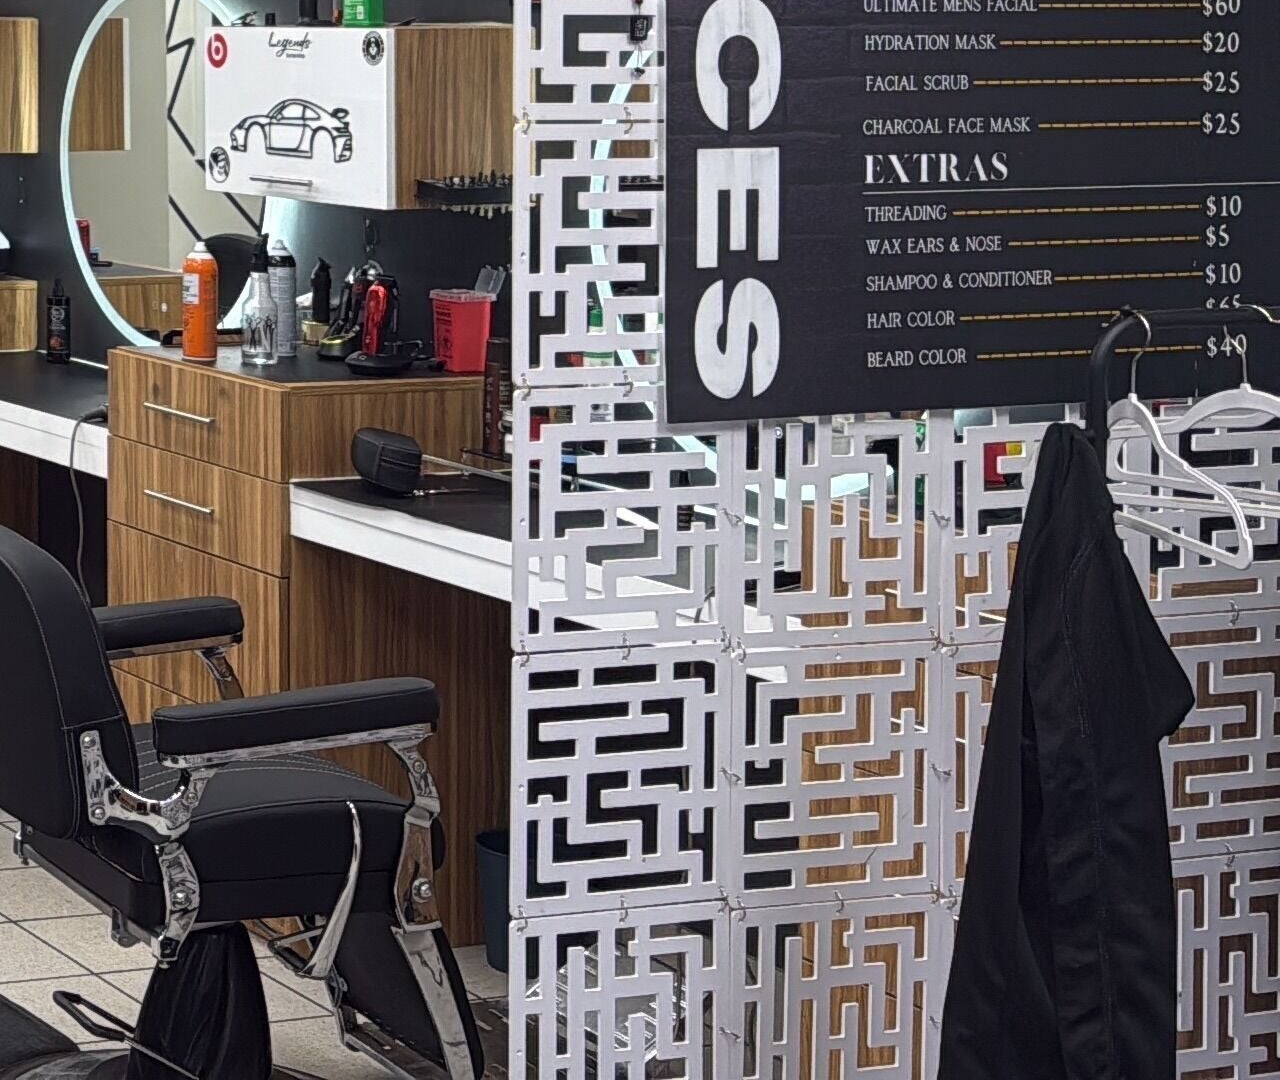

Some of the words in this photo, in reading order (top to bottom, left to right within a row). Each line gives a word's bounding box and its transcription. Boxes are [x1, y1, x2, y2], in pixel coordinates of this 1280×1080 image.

[268, 21, 312, 57] Legends
[864, 34, 950, 51] HYDRATION
[954, 33, 997, 50] MASK
[1202, 31, 1240, 53] $20
[865, 74, 918, 92] FACIAL
[923, 74, 969, 91] SCRUB
[1203, 70, 1240, 94] $25
[862, 117, 943, 136] CHARCOAL
[948, 117, 985, 134] FACE
[989, 116, 1031, 133] MASK
[1202, 112, 1240, 135] $25
[864, 152, 1008, 184] EXTRAS
[864, 204, 947, 223] THREADING
[1206, 194, 1242, 217] $10
[865, 238, 902, 255] WAX
[907, 237, 945, 254] EARS
[949, 236, 961, 253] &
[965, 235, 1002, 252] NOSE
[1206, 223, 1230, 248] $5
[865, 273, 938, 292] SHAMPOO
[942, 273, 954, 289] &
[958, 269, 1053, 289] CONDITIONER
[1205, 262, 1241, 286] $10
[867, 311, 902, 329] HAIR
[906, 310, 956, 328] COLOR
[867, 350, 914, 368] BEARD
[918, 347, 968, 366] COLOR
[1206, 333, 1248, 358] $40
